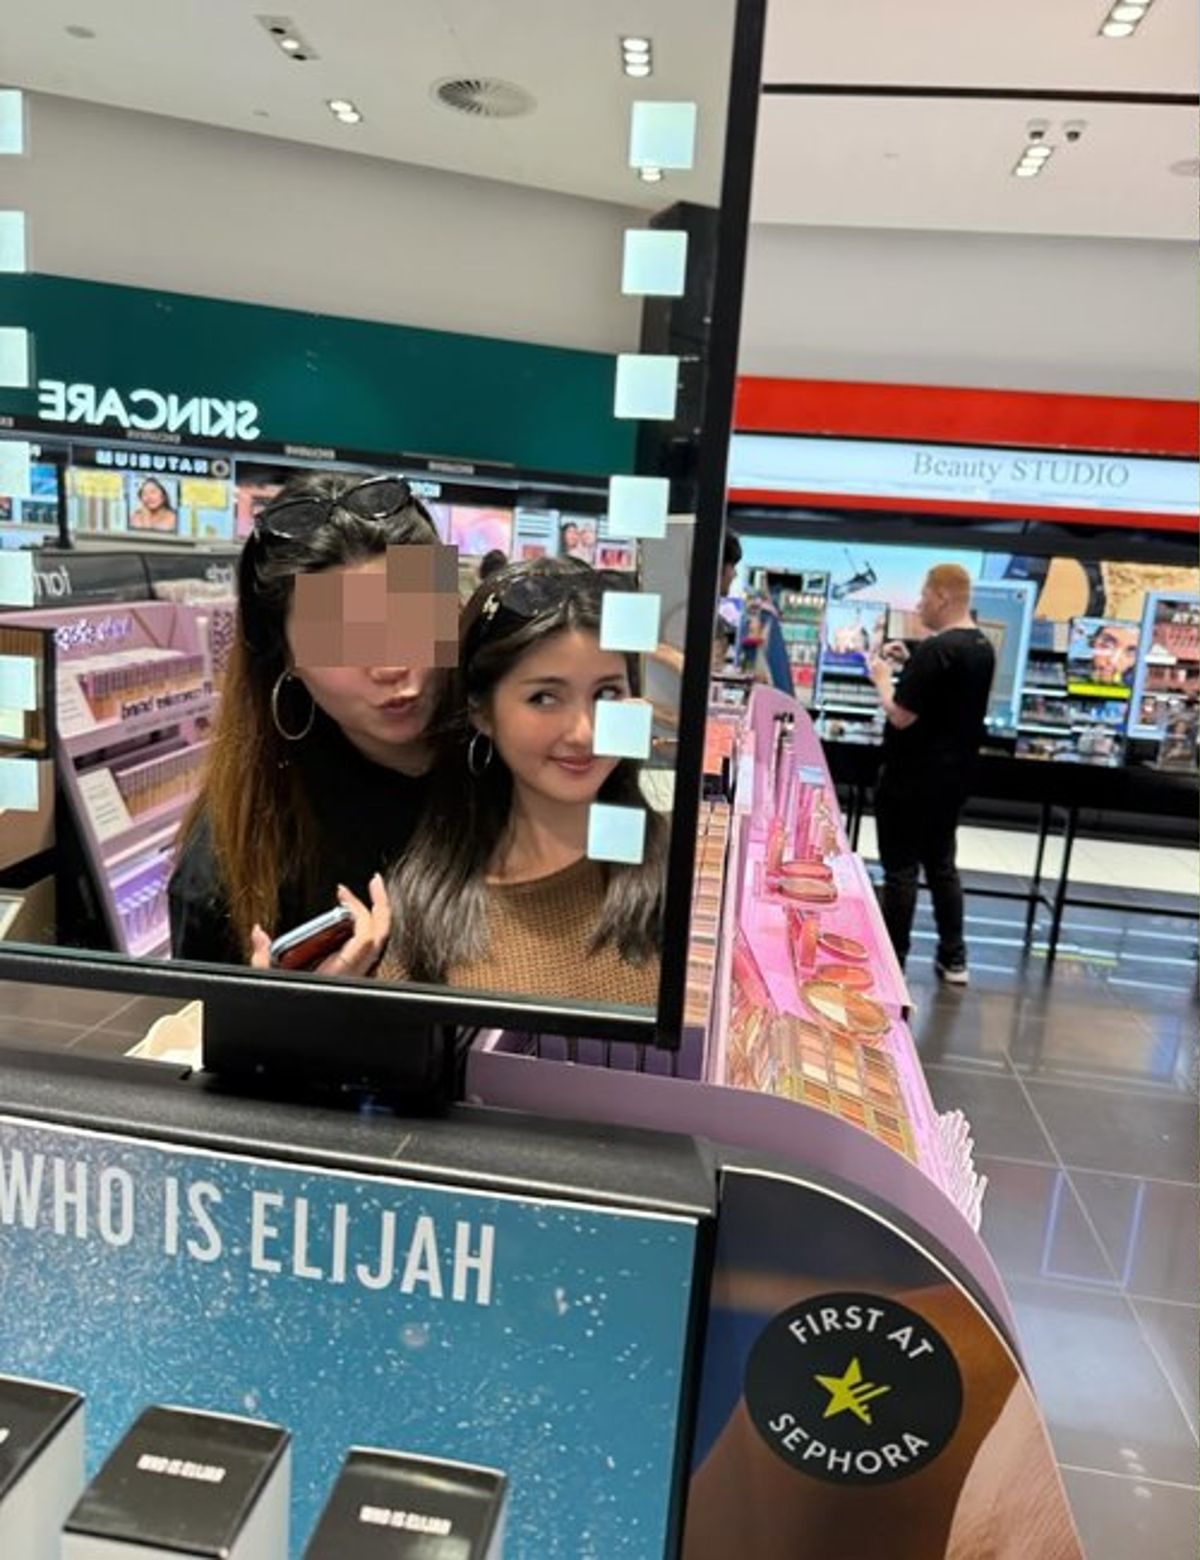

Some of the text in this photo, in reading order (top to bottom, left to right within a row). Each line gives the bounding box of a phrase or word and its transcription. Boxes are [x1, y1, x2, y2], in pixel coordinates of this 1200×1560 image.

[913, 451, 1130, 488] Beauty STUDIO
[0, 1148, 496, 1307] WHO IS ELIJAH
[789, 1306, 935, 1359] FIRST AT
[768, 1413, 930, 1474] SEPHORA
